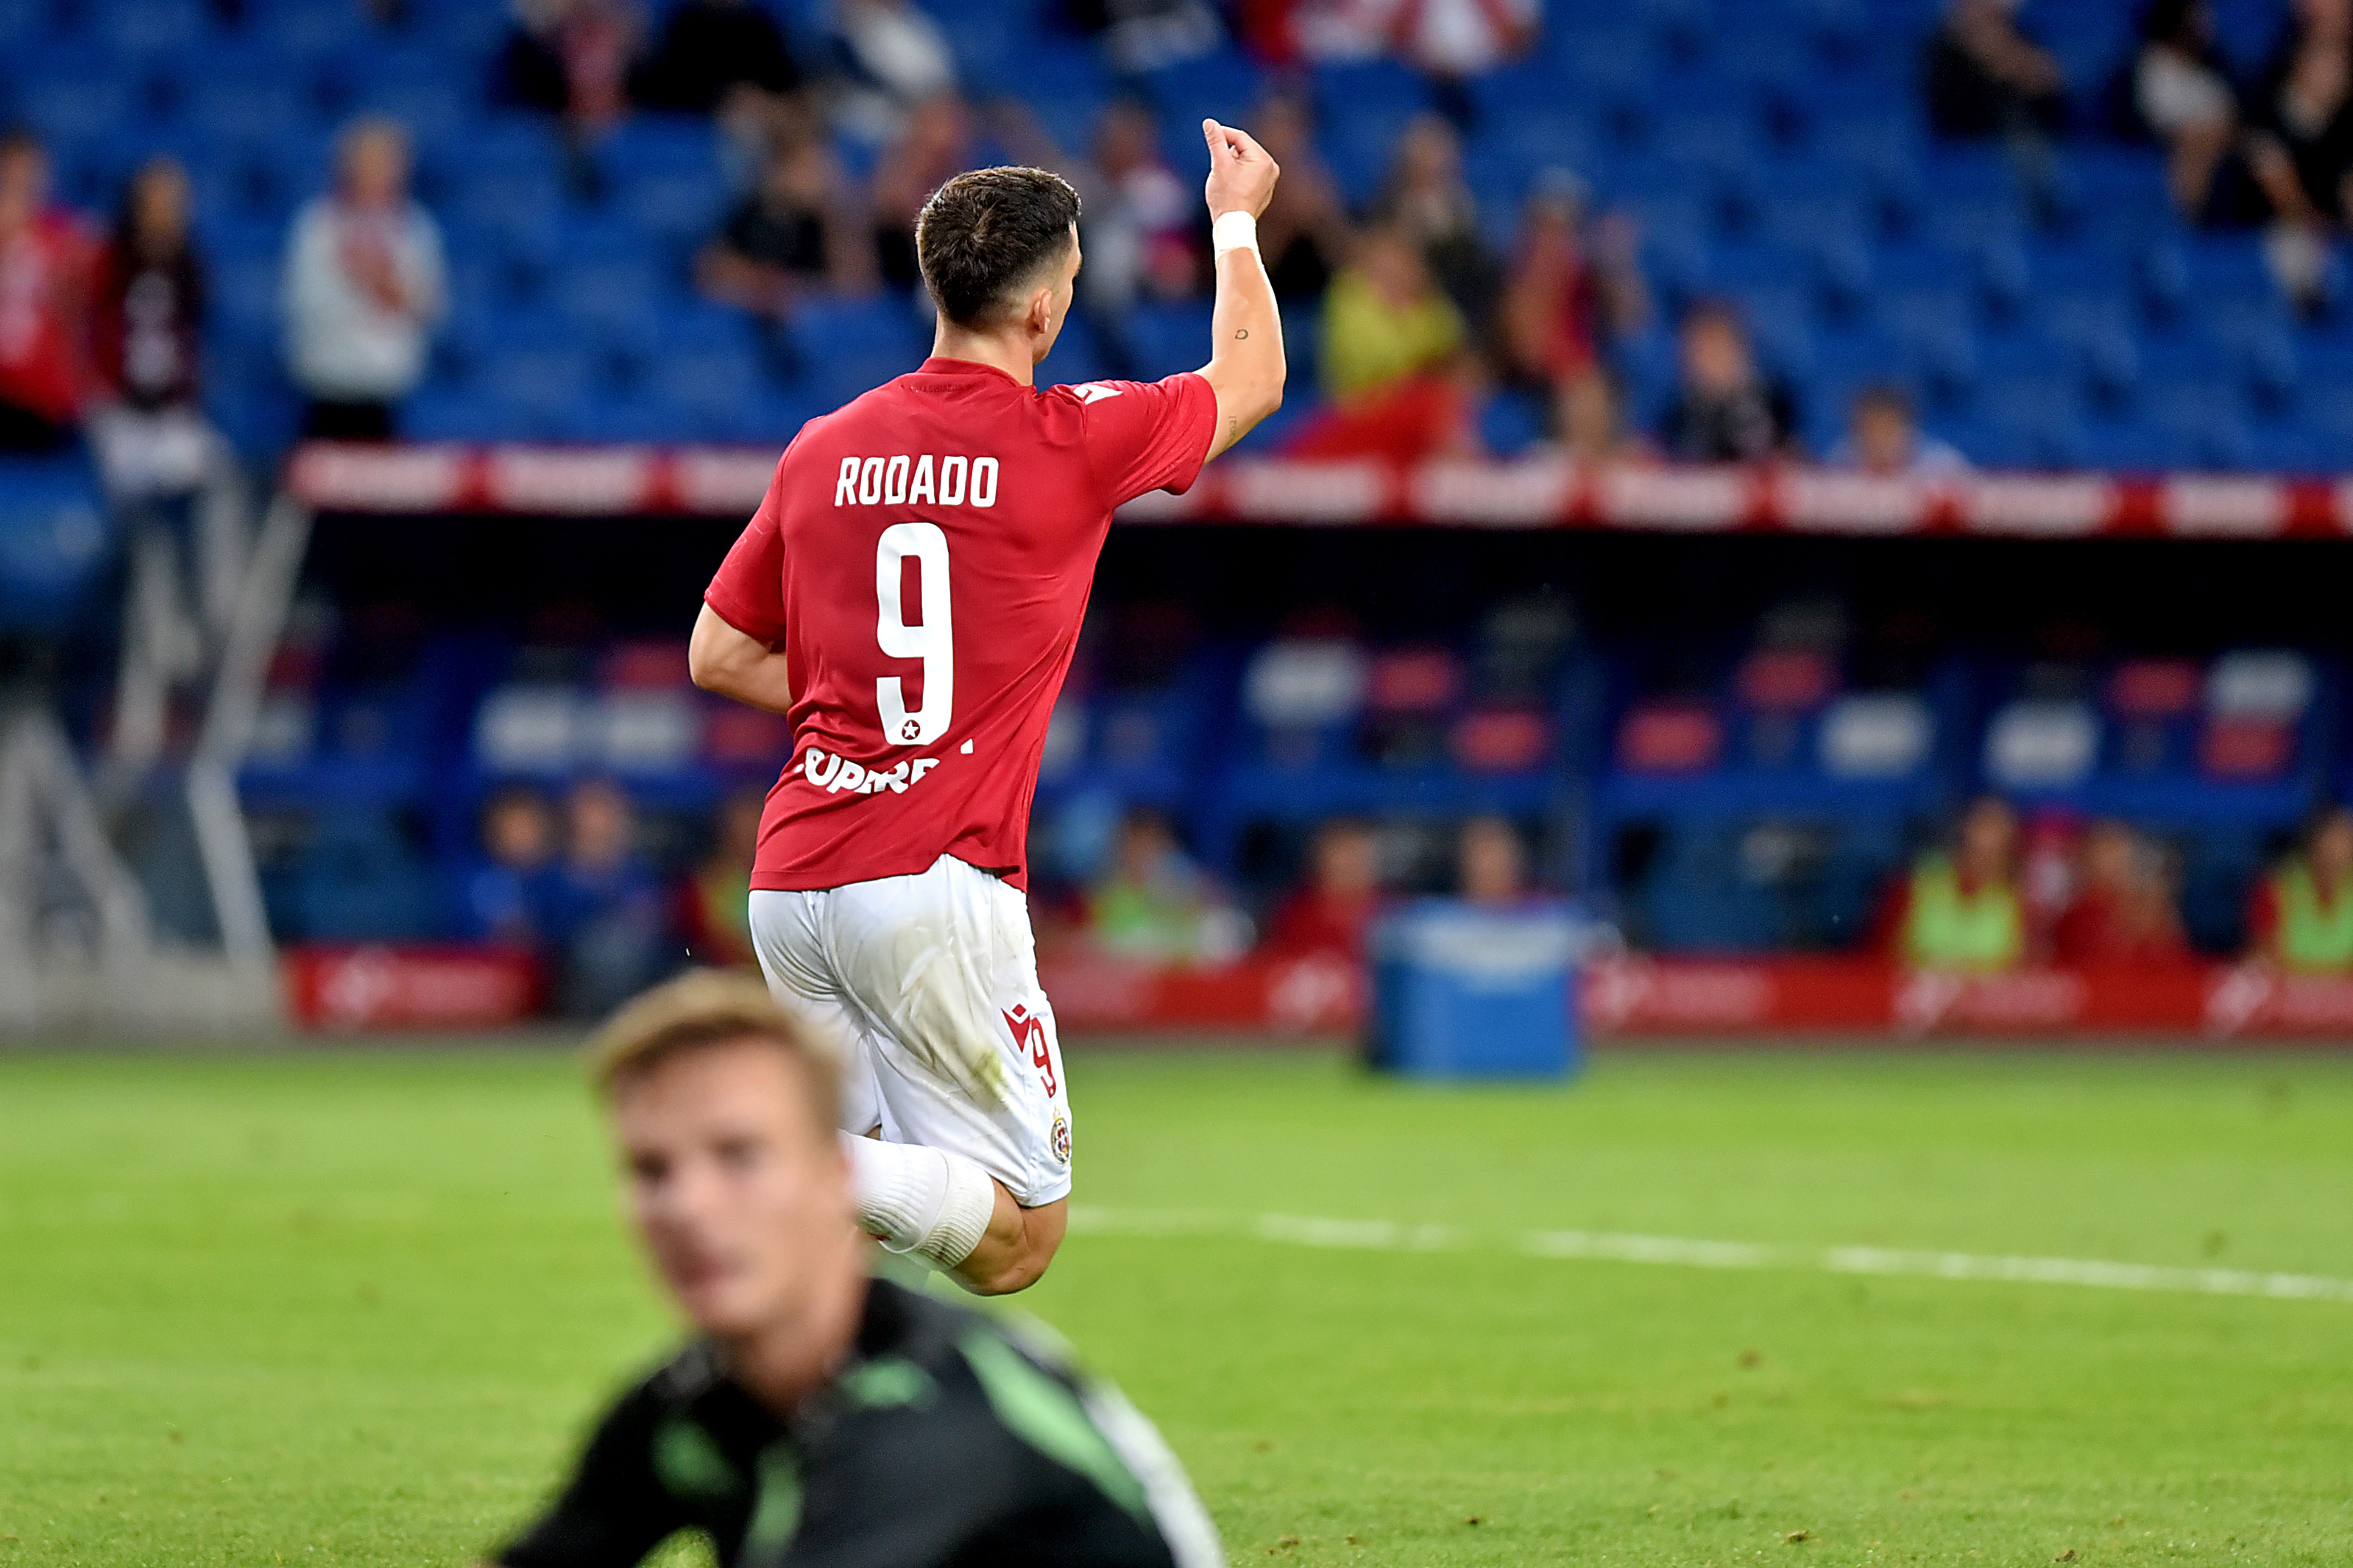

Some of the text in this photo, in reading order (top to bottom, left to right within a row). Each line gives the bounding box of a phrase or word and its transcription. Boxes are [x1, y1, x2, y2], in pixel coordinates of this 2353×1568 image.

[834, 454, 999, 508] RODADO
[876, 522, 954, 746] 9
[1031, 1016, 1056, 1099] 9
